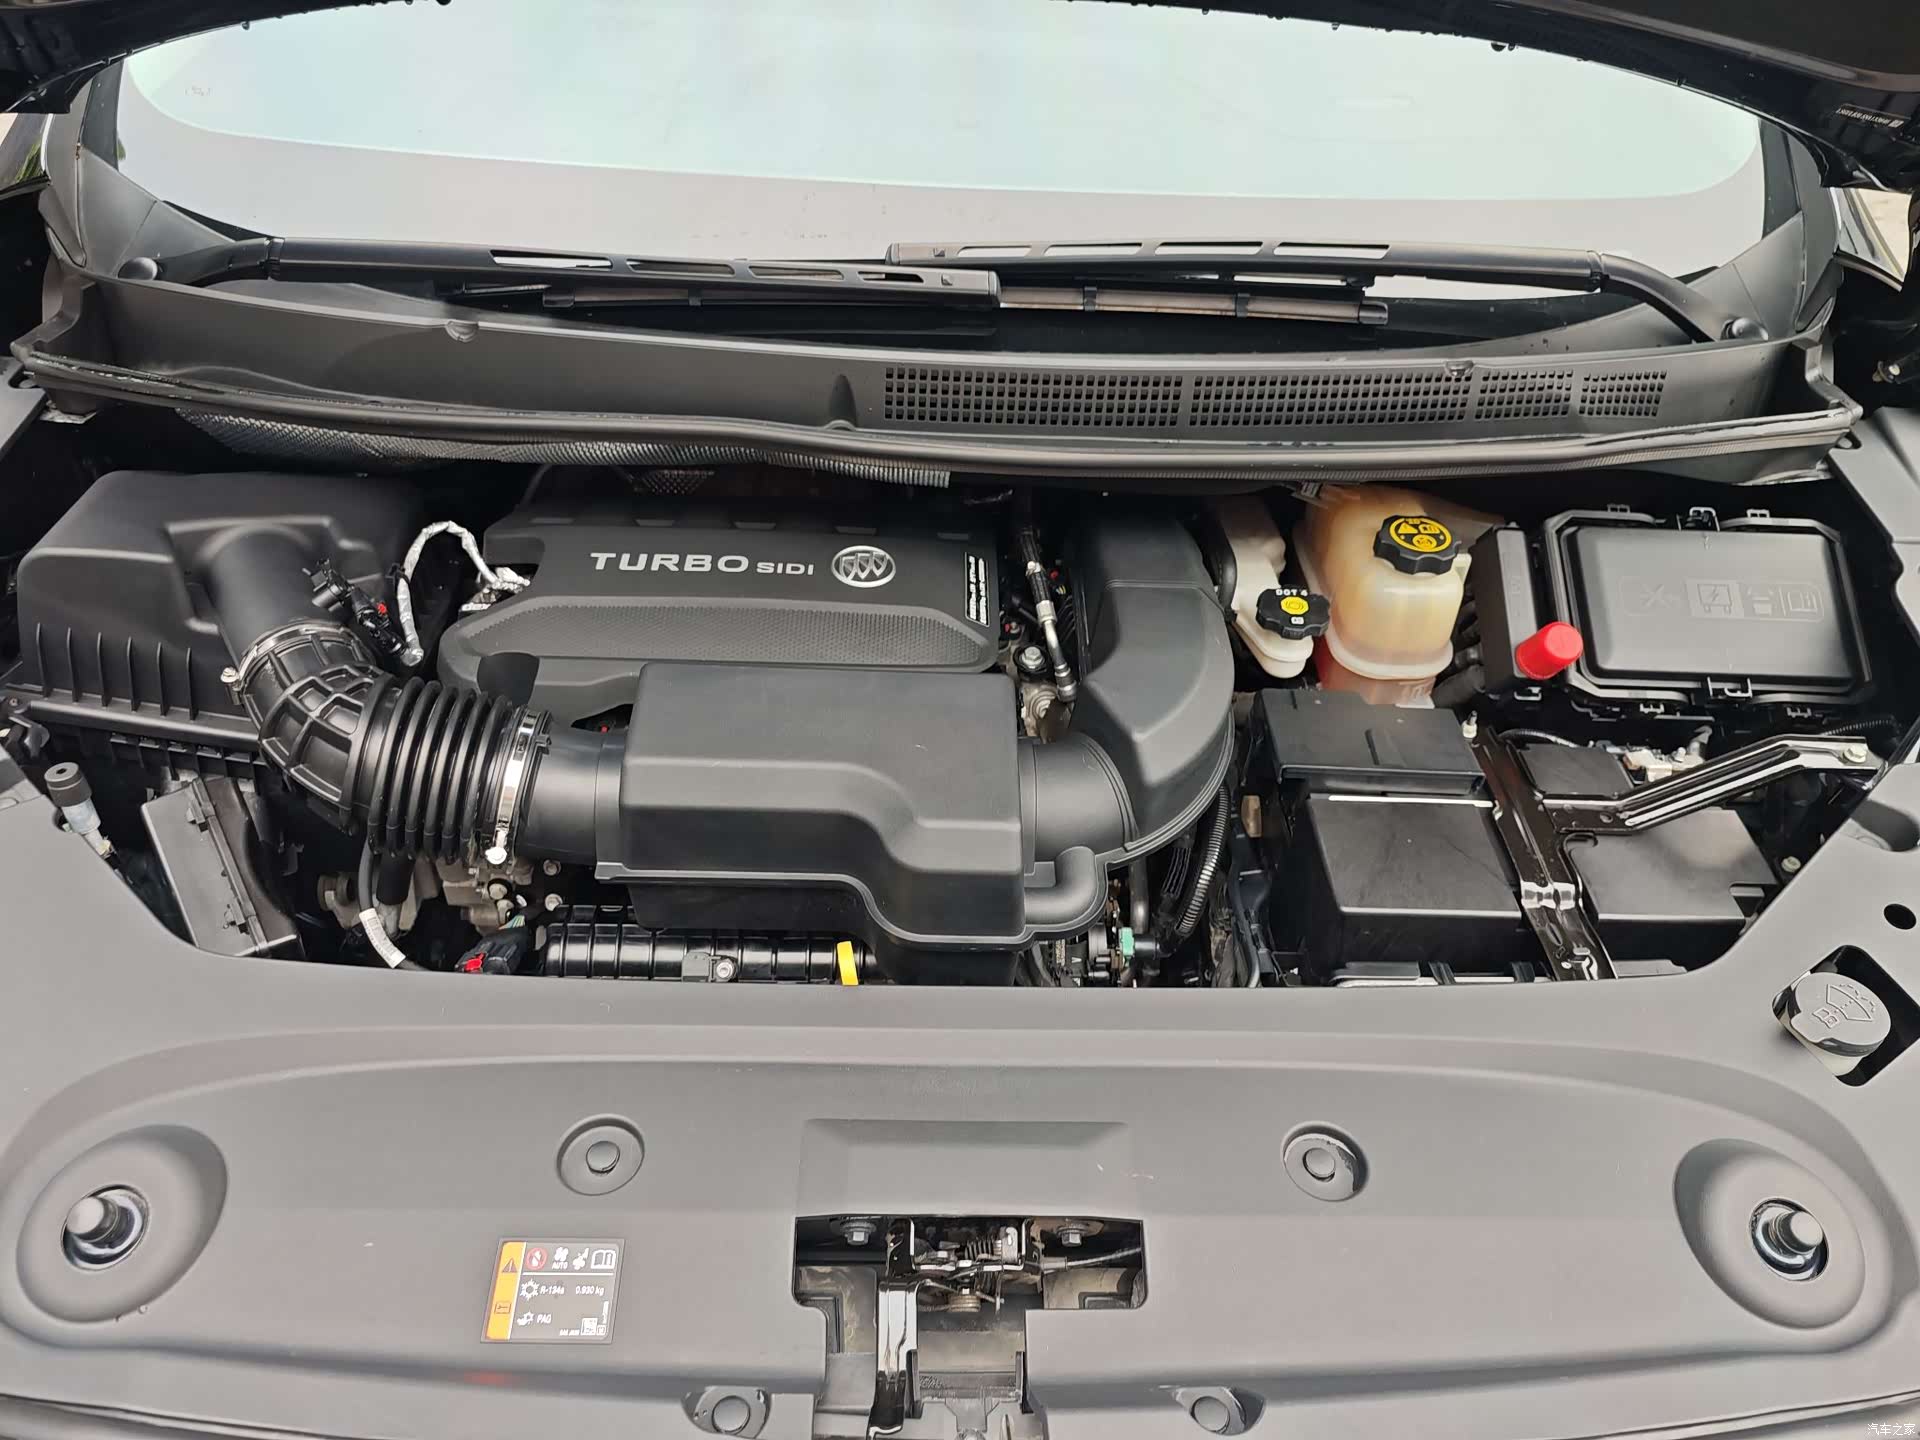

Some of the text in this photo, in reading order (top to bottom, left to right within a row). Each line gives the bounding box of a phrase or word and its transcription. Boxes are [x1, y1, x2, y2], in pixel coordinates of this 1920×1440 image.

[590, 552, 815, 576] TURBO SIDI
[1275, 588, 1298, 596] DOT
[551, 1261, 569, 1270] AUTO
